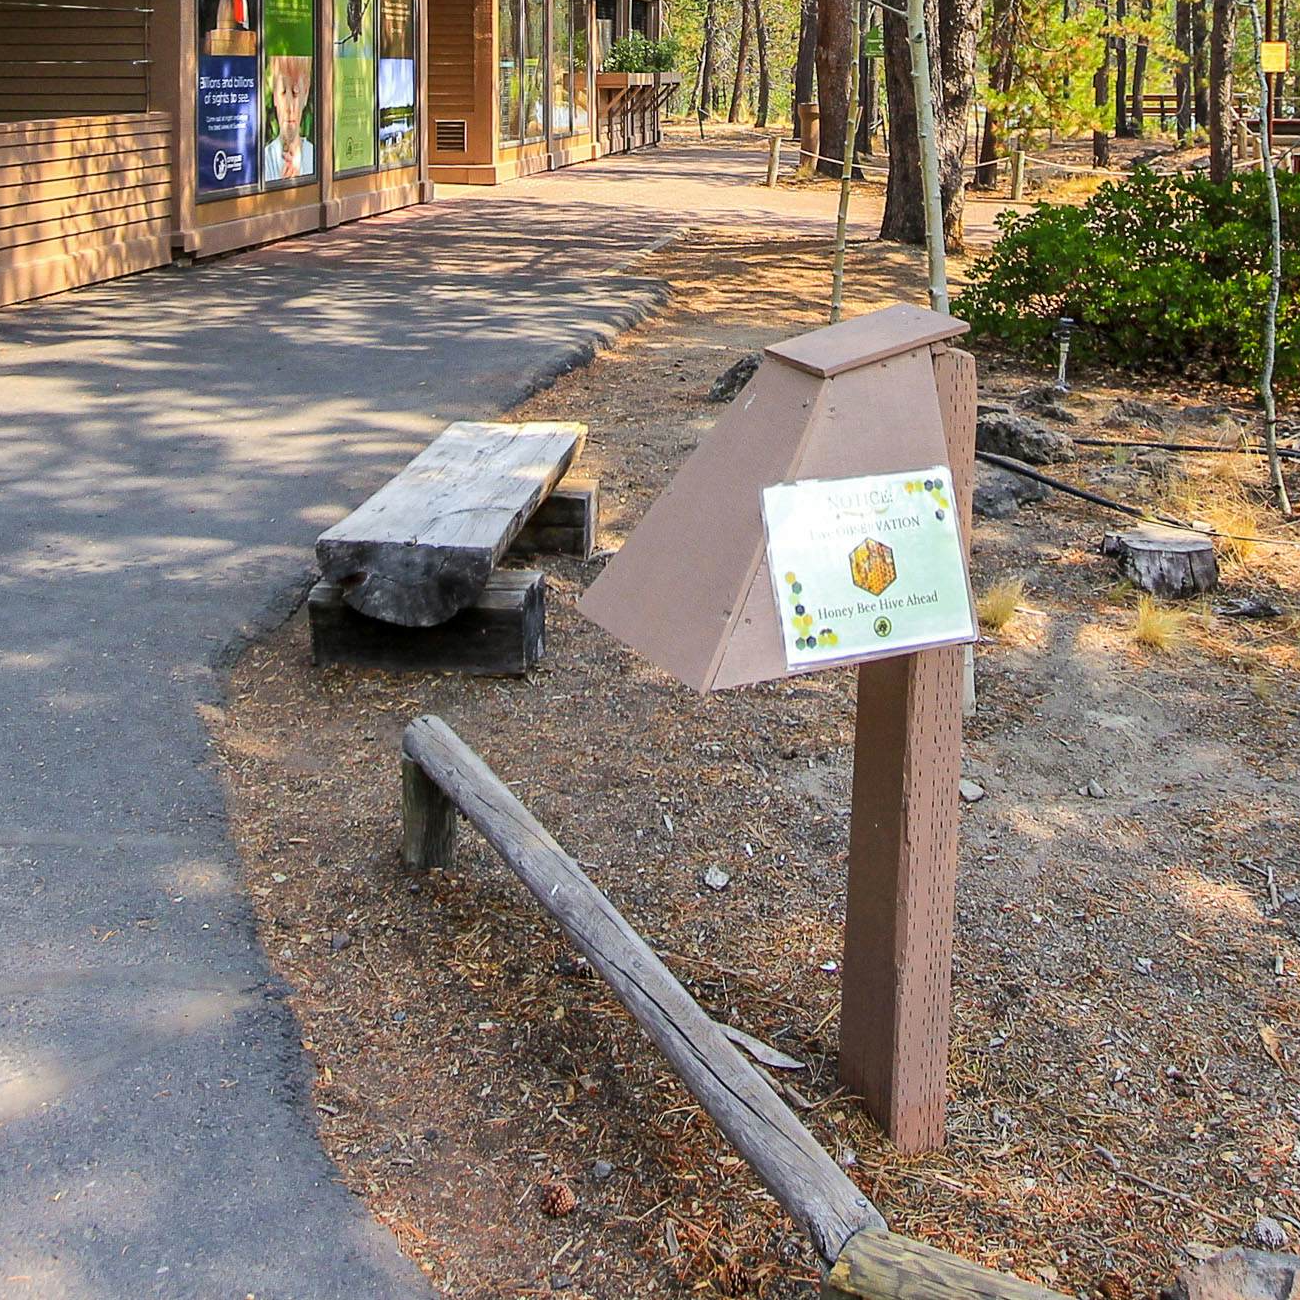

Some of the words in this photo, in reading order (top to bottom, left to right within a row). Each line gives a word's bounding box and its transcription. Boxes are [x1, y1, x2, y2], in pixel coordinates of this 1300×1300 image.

[199, 76, 220, 89] Billions
[221, 77, 233, 88] and
[233, 76, 254, 88] billions
[204, 91, 211, 104] of
[211, 92, 229, 106] sights
[230, 92, 237, 103] to
[827, 489, 893, 509] NOTICE:
[818, 606, 854, 620] Honey
[857, 602, 877, 614] Bee
[879, 598, 904, 611] Hive
[905, 590, 939, 607] Ahead
